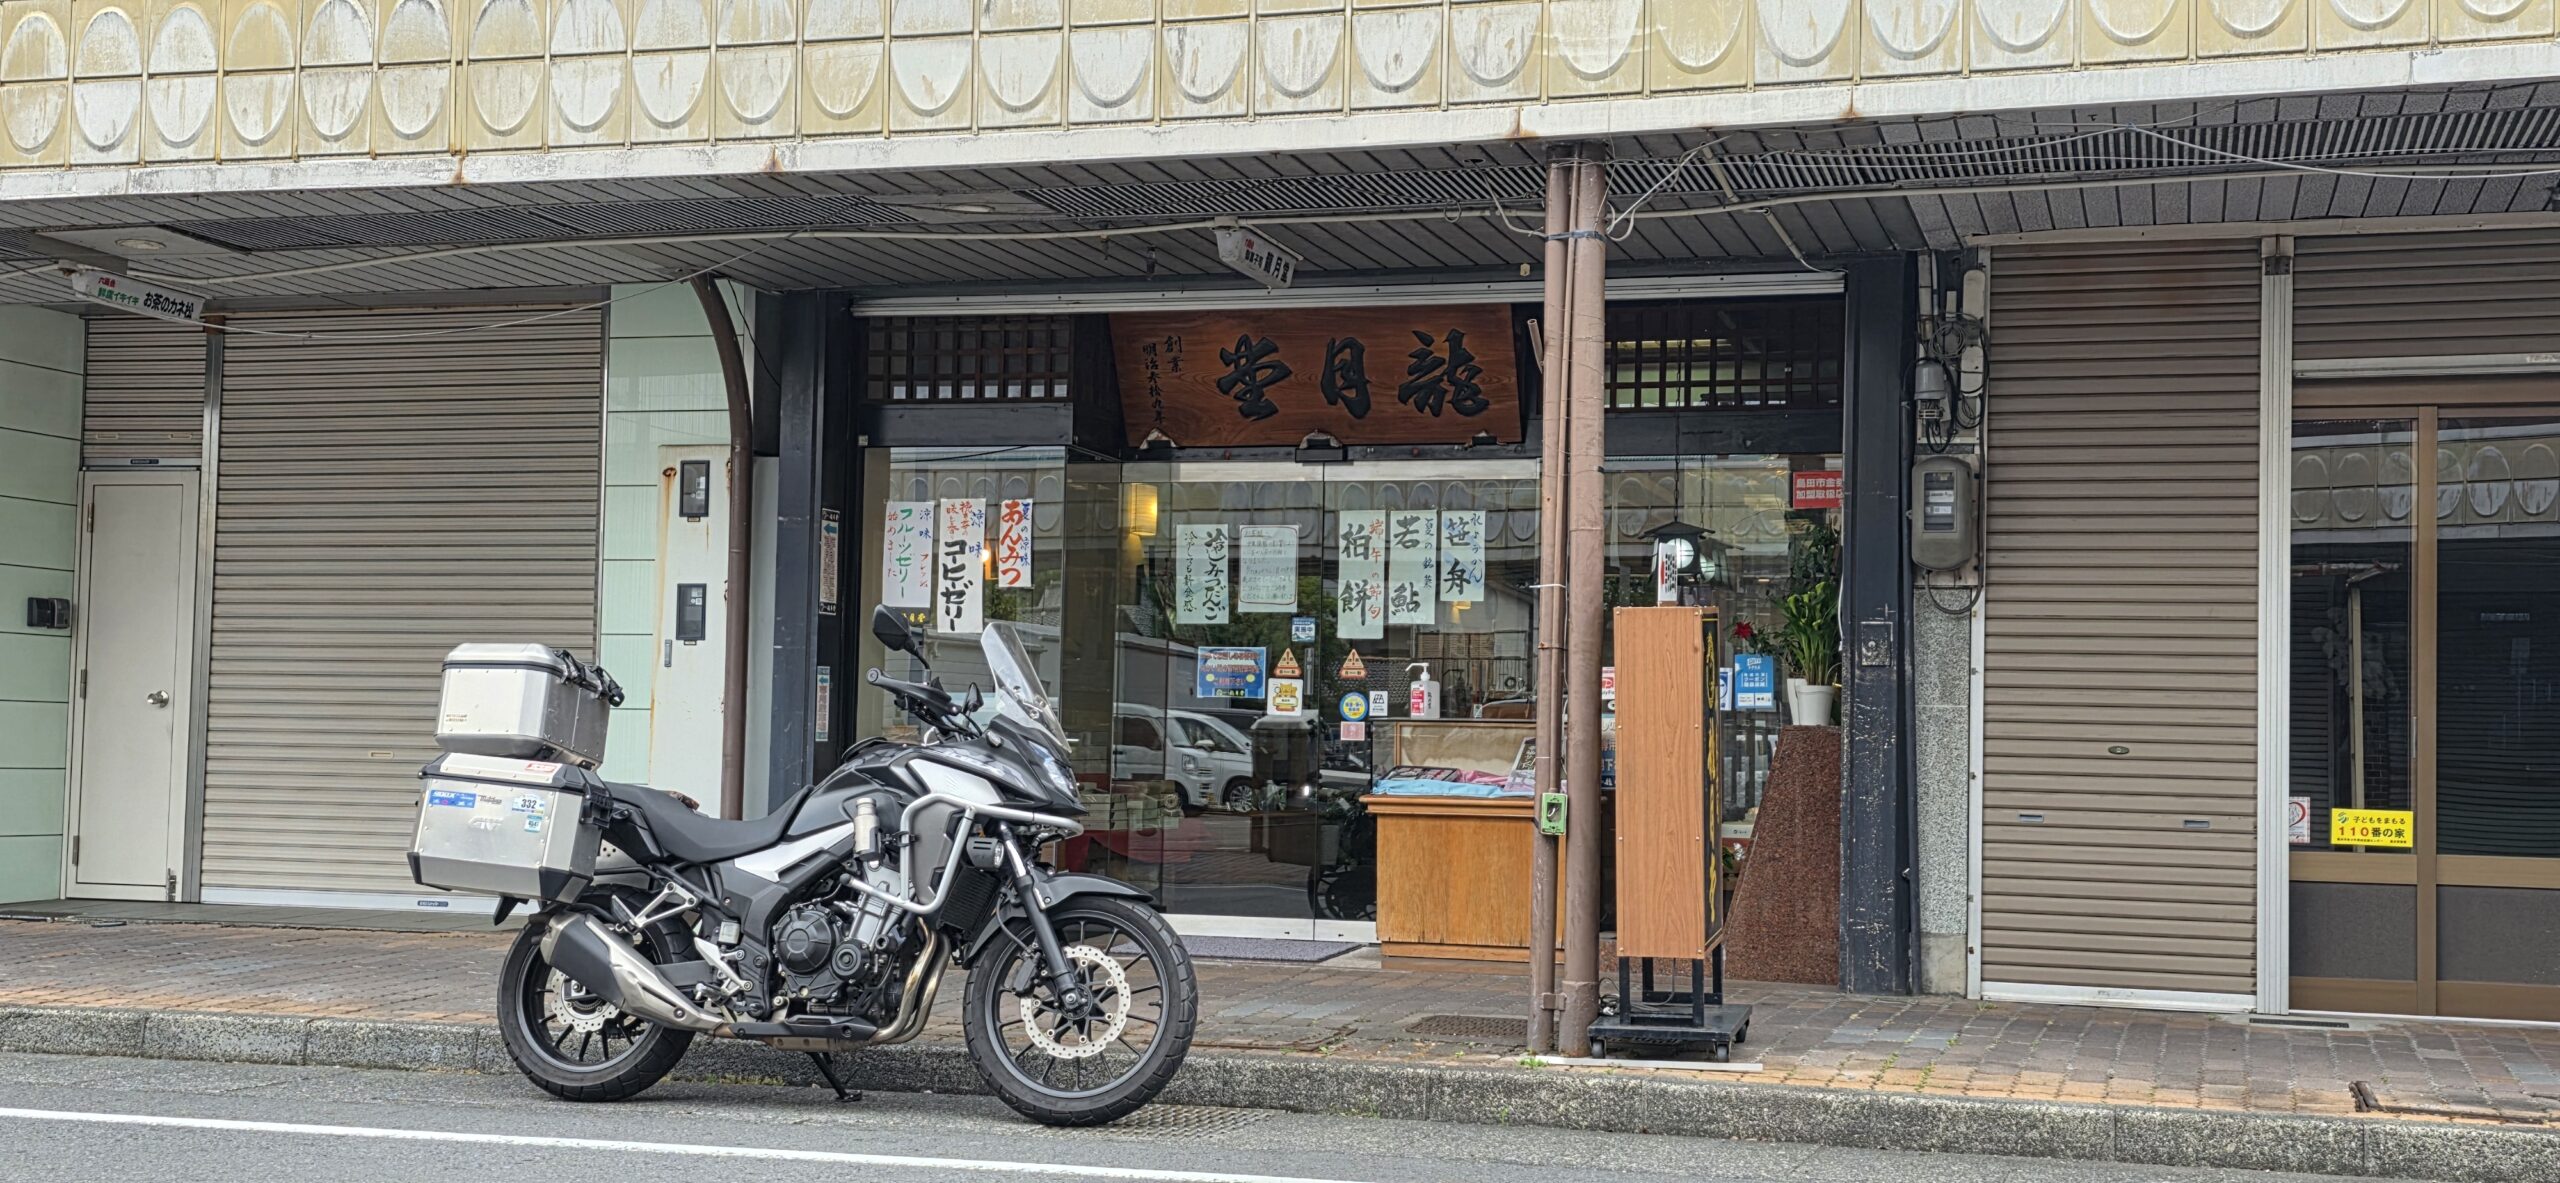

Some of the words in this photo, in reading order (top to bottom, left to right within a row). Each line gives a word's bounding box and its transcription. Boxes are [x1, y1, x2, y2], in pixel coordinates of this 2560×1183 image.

[143, 291, 195, 319] お茶のカネ松
[1164, 335, 1184, 373] 創業
[886, 511, 898, 577] 始めました
[896, 508, 916, 598] フルーツゼリー
[919, 508, 933, 539] 涼味
[969, 509, 985, 558] 涼味
[1000, 501, 1023, 585] あんみつ
[1020, 502, 1031, 566] 夏の涼味
[1443, 516, 1472, 595] 笹舟
[1468, 513, 1483, 583] 水ようかん
[940, 540, 974, 631] コーヒーゼリー
[1202, 528, 1228, 621] 冷やしみつだんご
[1338, 523, 1372, 626] 柏餅
[1367, 519, 1384, 620] 端午の節句
[1391, 515, 1421, 616] 若鮎
[521, 799, 537, 809] 332
[2338, 826, 2405, 839] 110番の家
[2352, 815, 2406, 825] 子どもをまもる
